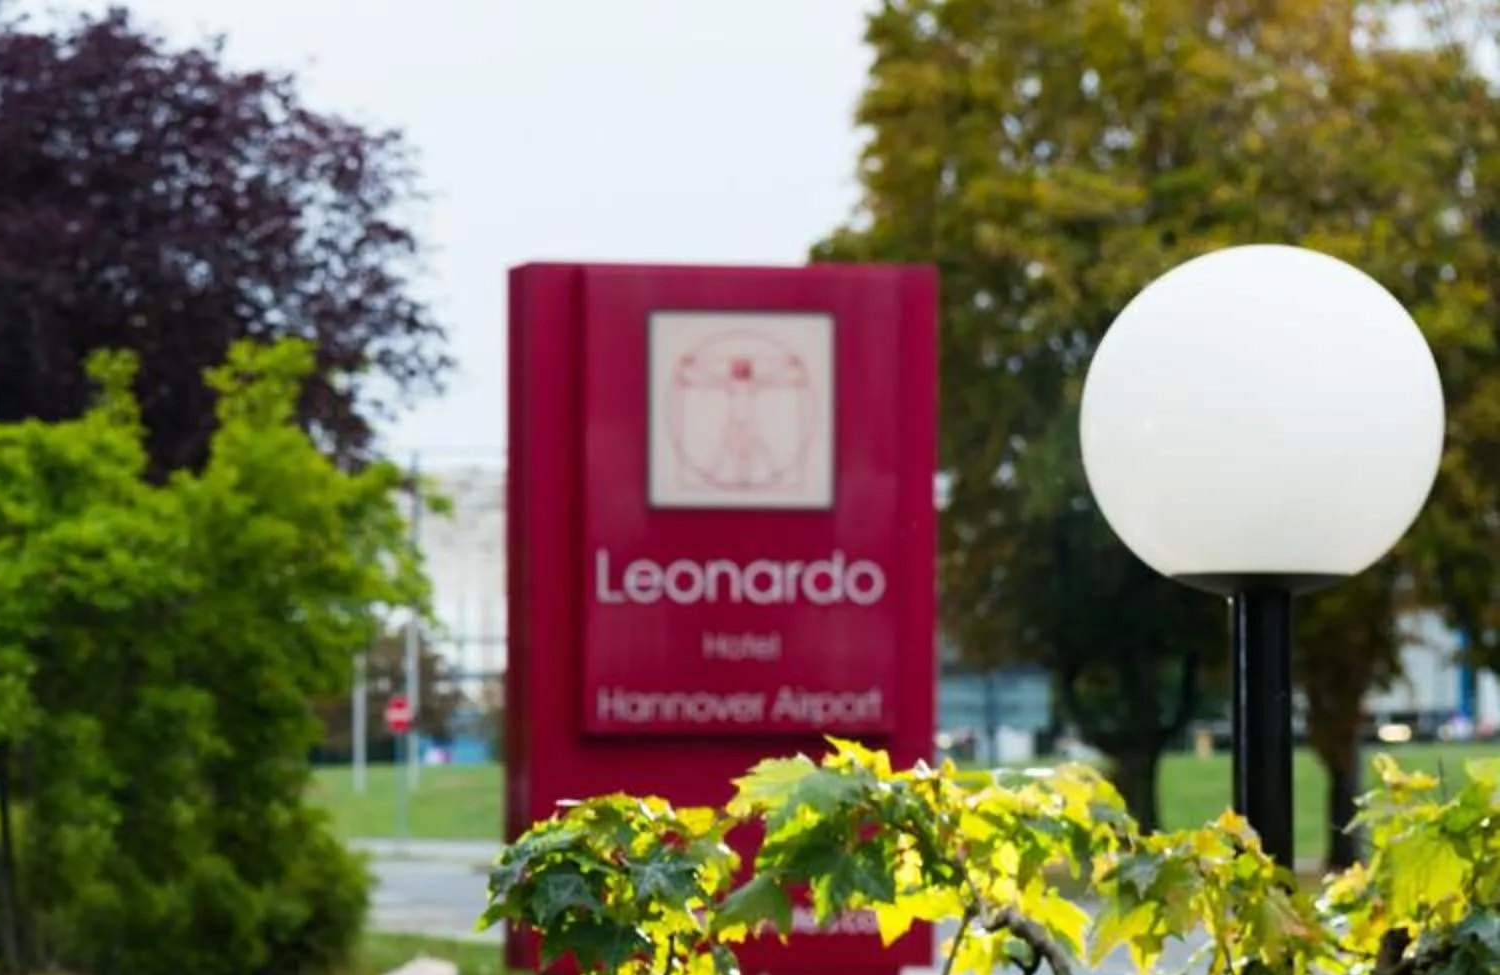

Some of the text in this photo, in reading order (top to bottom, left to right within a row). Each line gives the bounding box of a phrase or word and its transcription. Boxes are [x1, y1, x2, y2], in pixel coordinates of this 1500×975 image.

[595, 547, 886, 605] Leonardo
[703, 632, 780, 660] Hotel
[597, 686, 882, 726] Hannover Airport
